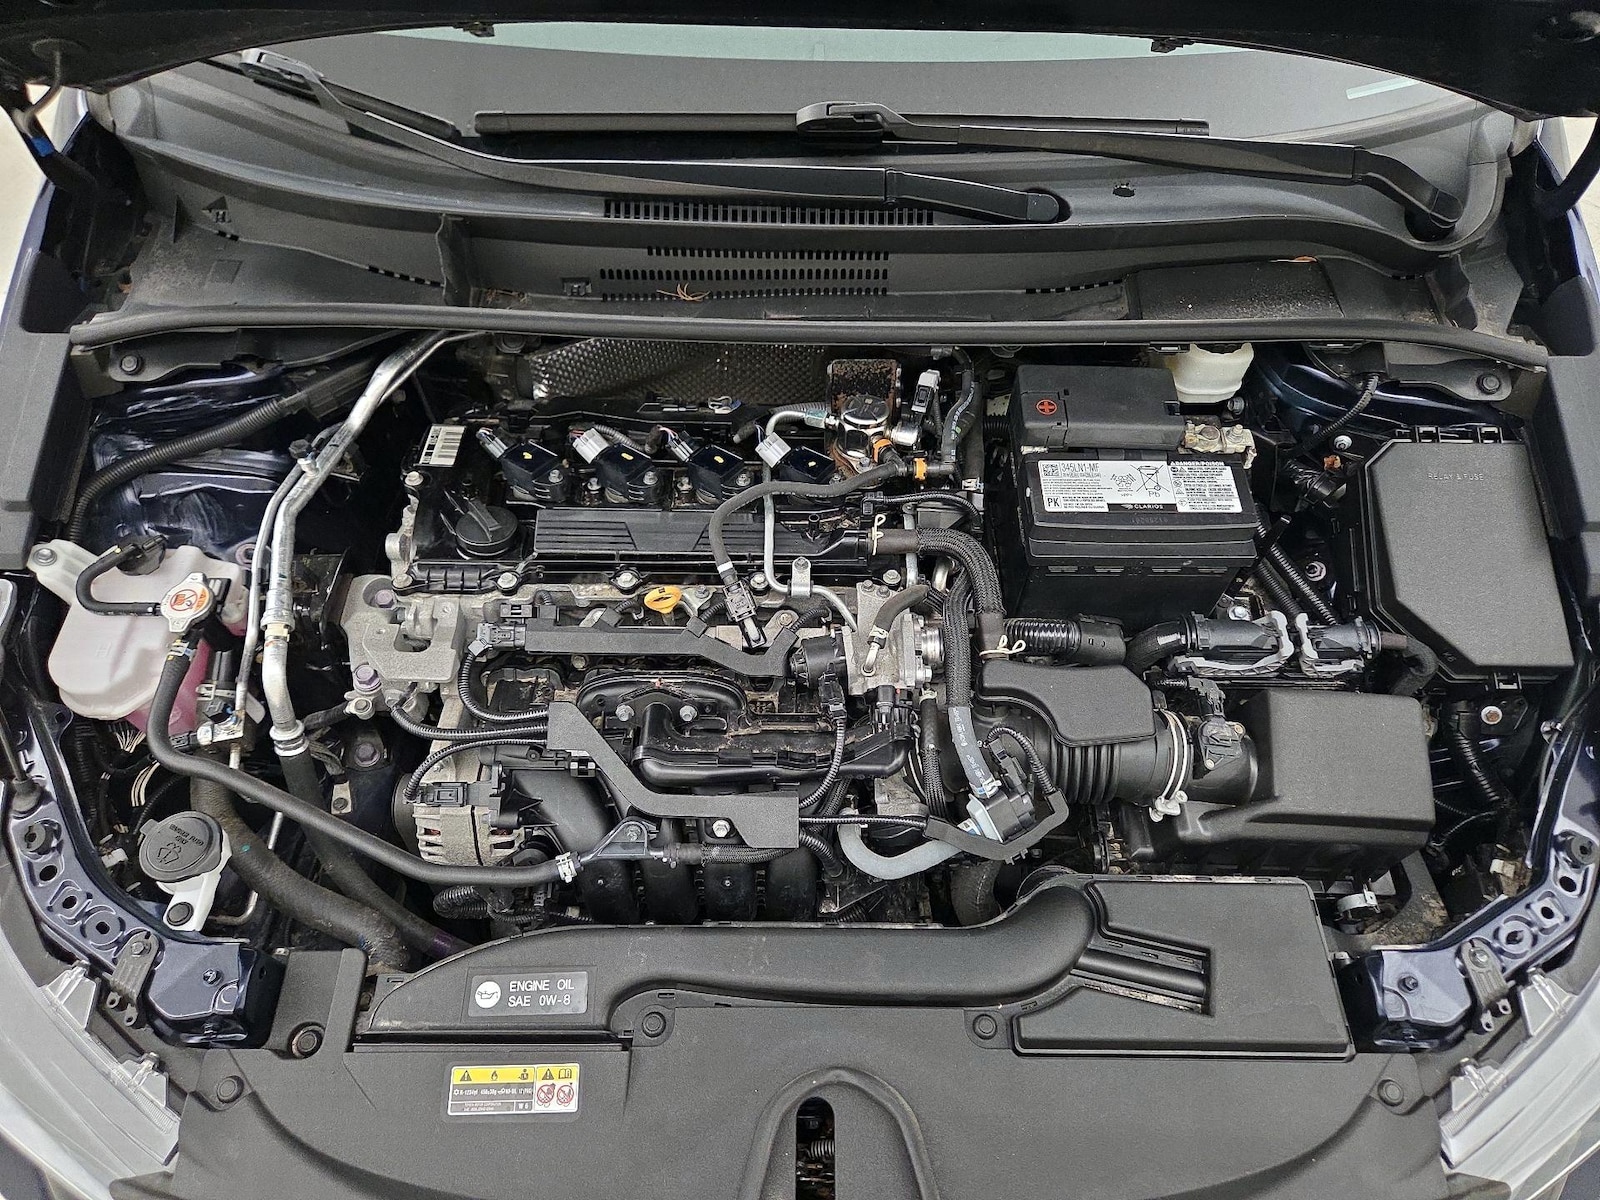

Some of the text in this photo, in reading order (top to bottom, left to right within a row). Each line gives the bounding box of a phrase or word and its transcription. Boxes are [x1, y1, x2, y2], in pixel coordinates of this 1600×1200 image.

[1061, 463, 1099, 472] 345LN1-MF
[1463, 473, 1485, 481] FUSE
[1148, 490, 1161, 498] Pb
[1047, 497, 1060, 507] PK
[509, 978, 575, 992] ENGINE OIL
[507, 994, 571, 1007] SAE 0W-8
